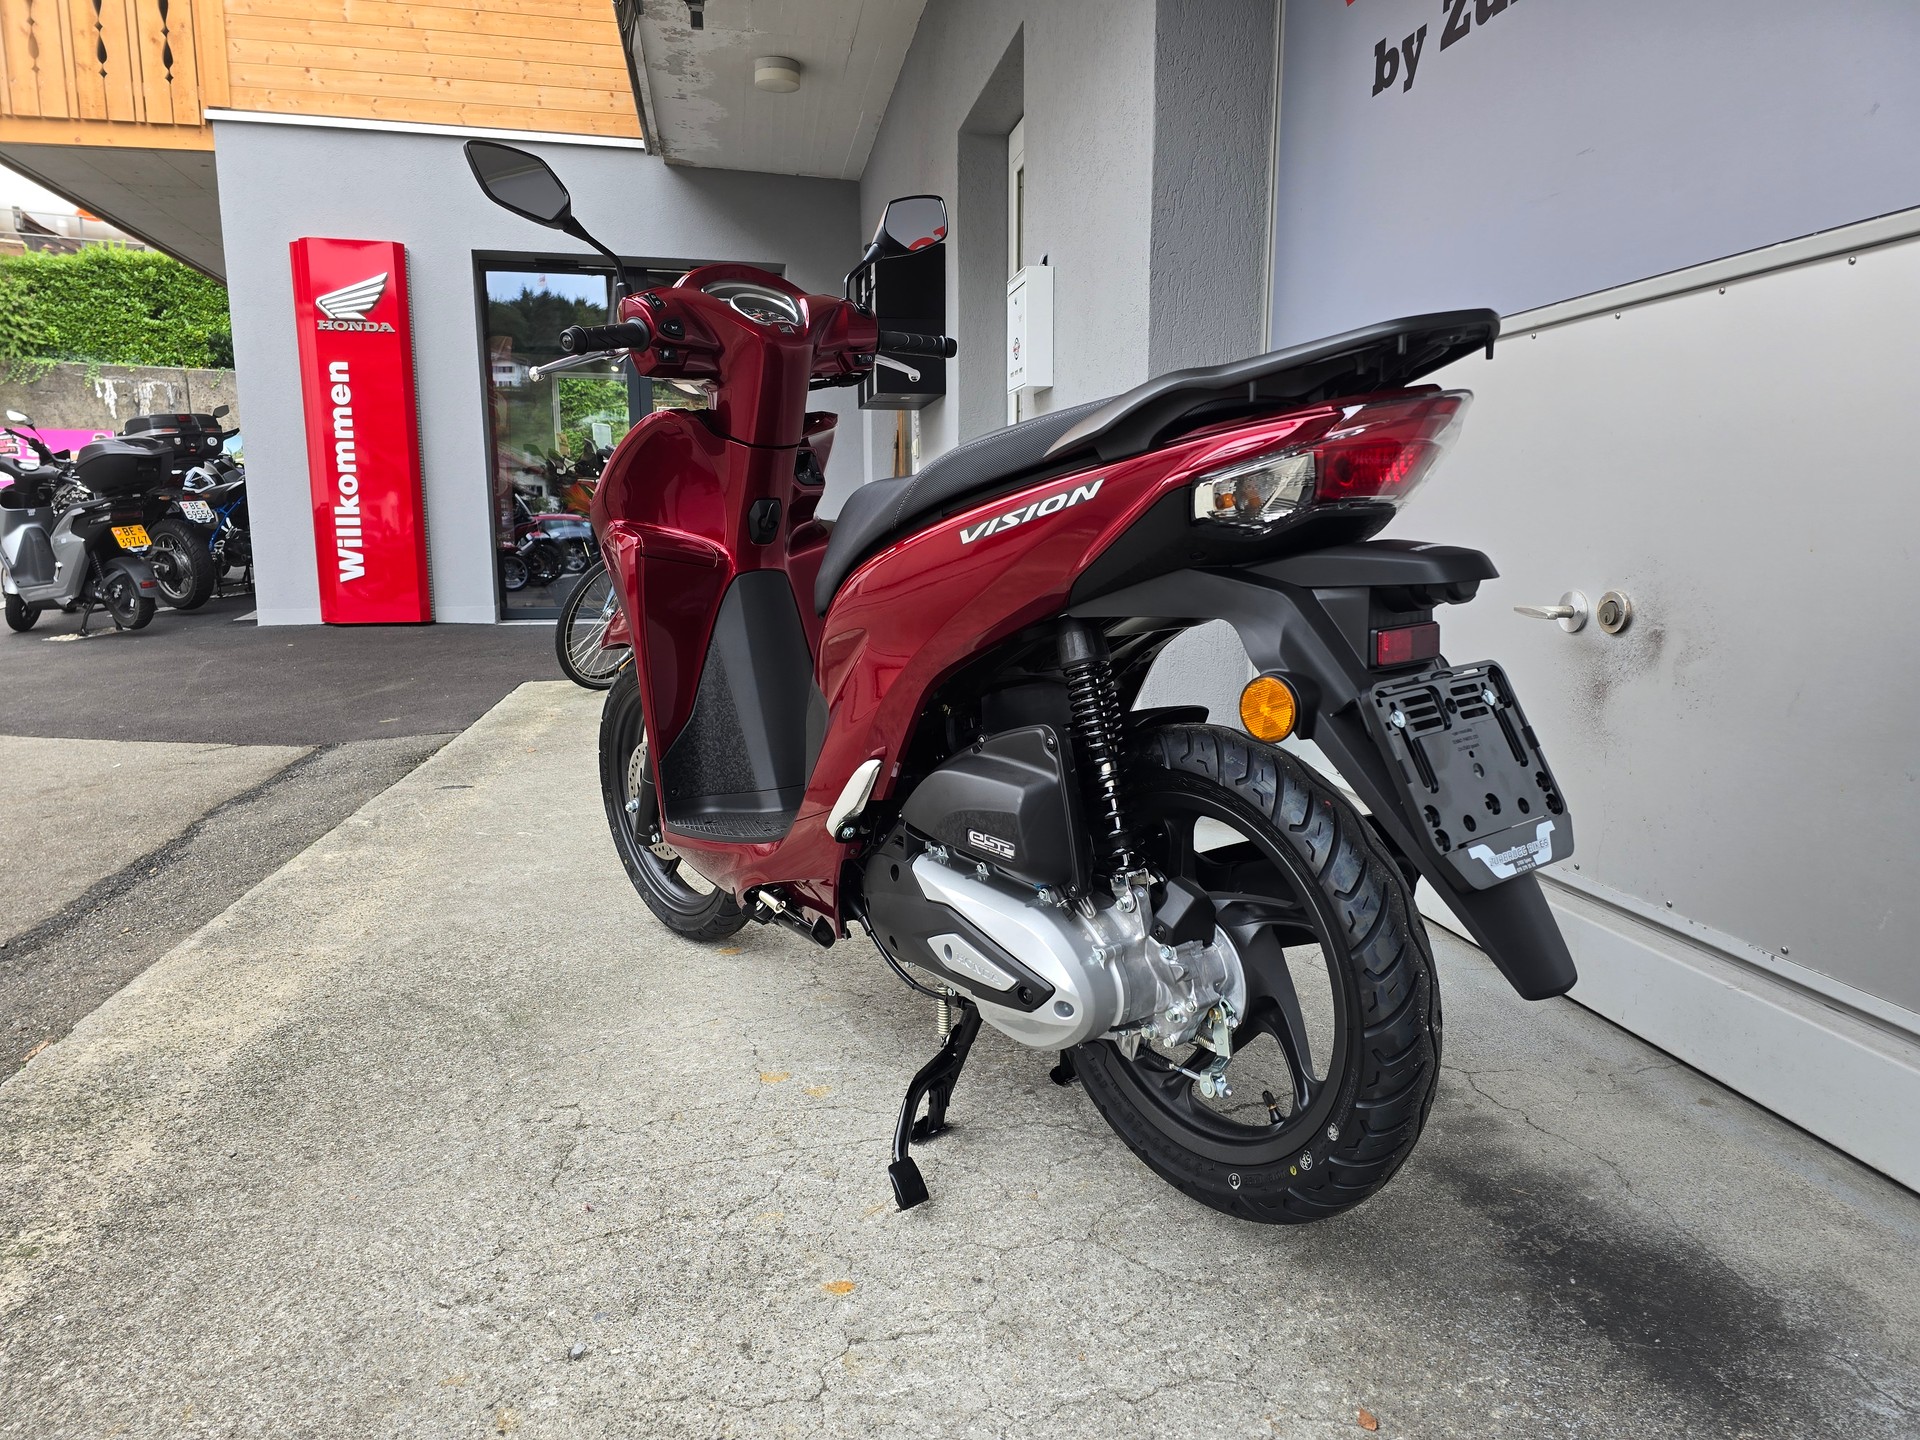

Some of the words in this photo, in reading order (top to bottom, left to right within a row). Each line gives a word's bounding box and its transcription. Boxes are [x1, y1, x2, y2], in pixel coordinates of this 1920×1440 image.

[1372, 23, 1427, 97] by
[1440, 0, 1519, 52] Zu
[317, 320, 396, 333] HONDA
[328, 361, 365, 583] Willkommen
[122, 527, 136, 536] BE
[959, 478, 1105, 545] VISION
[120, 536, 148, 547] 39747
